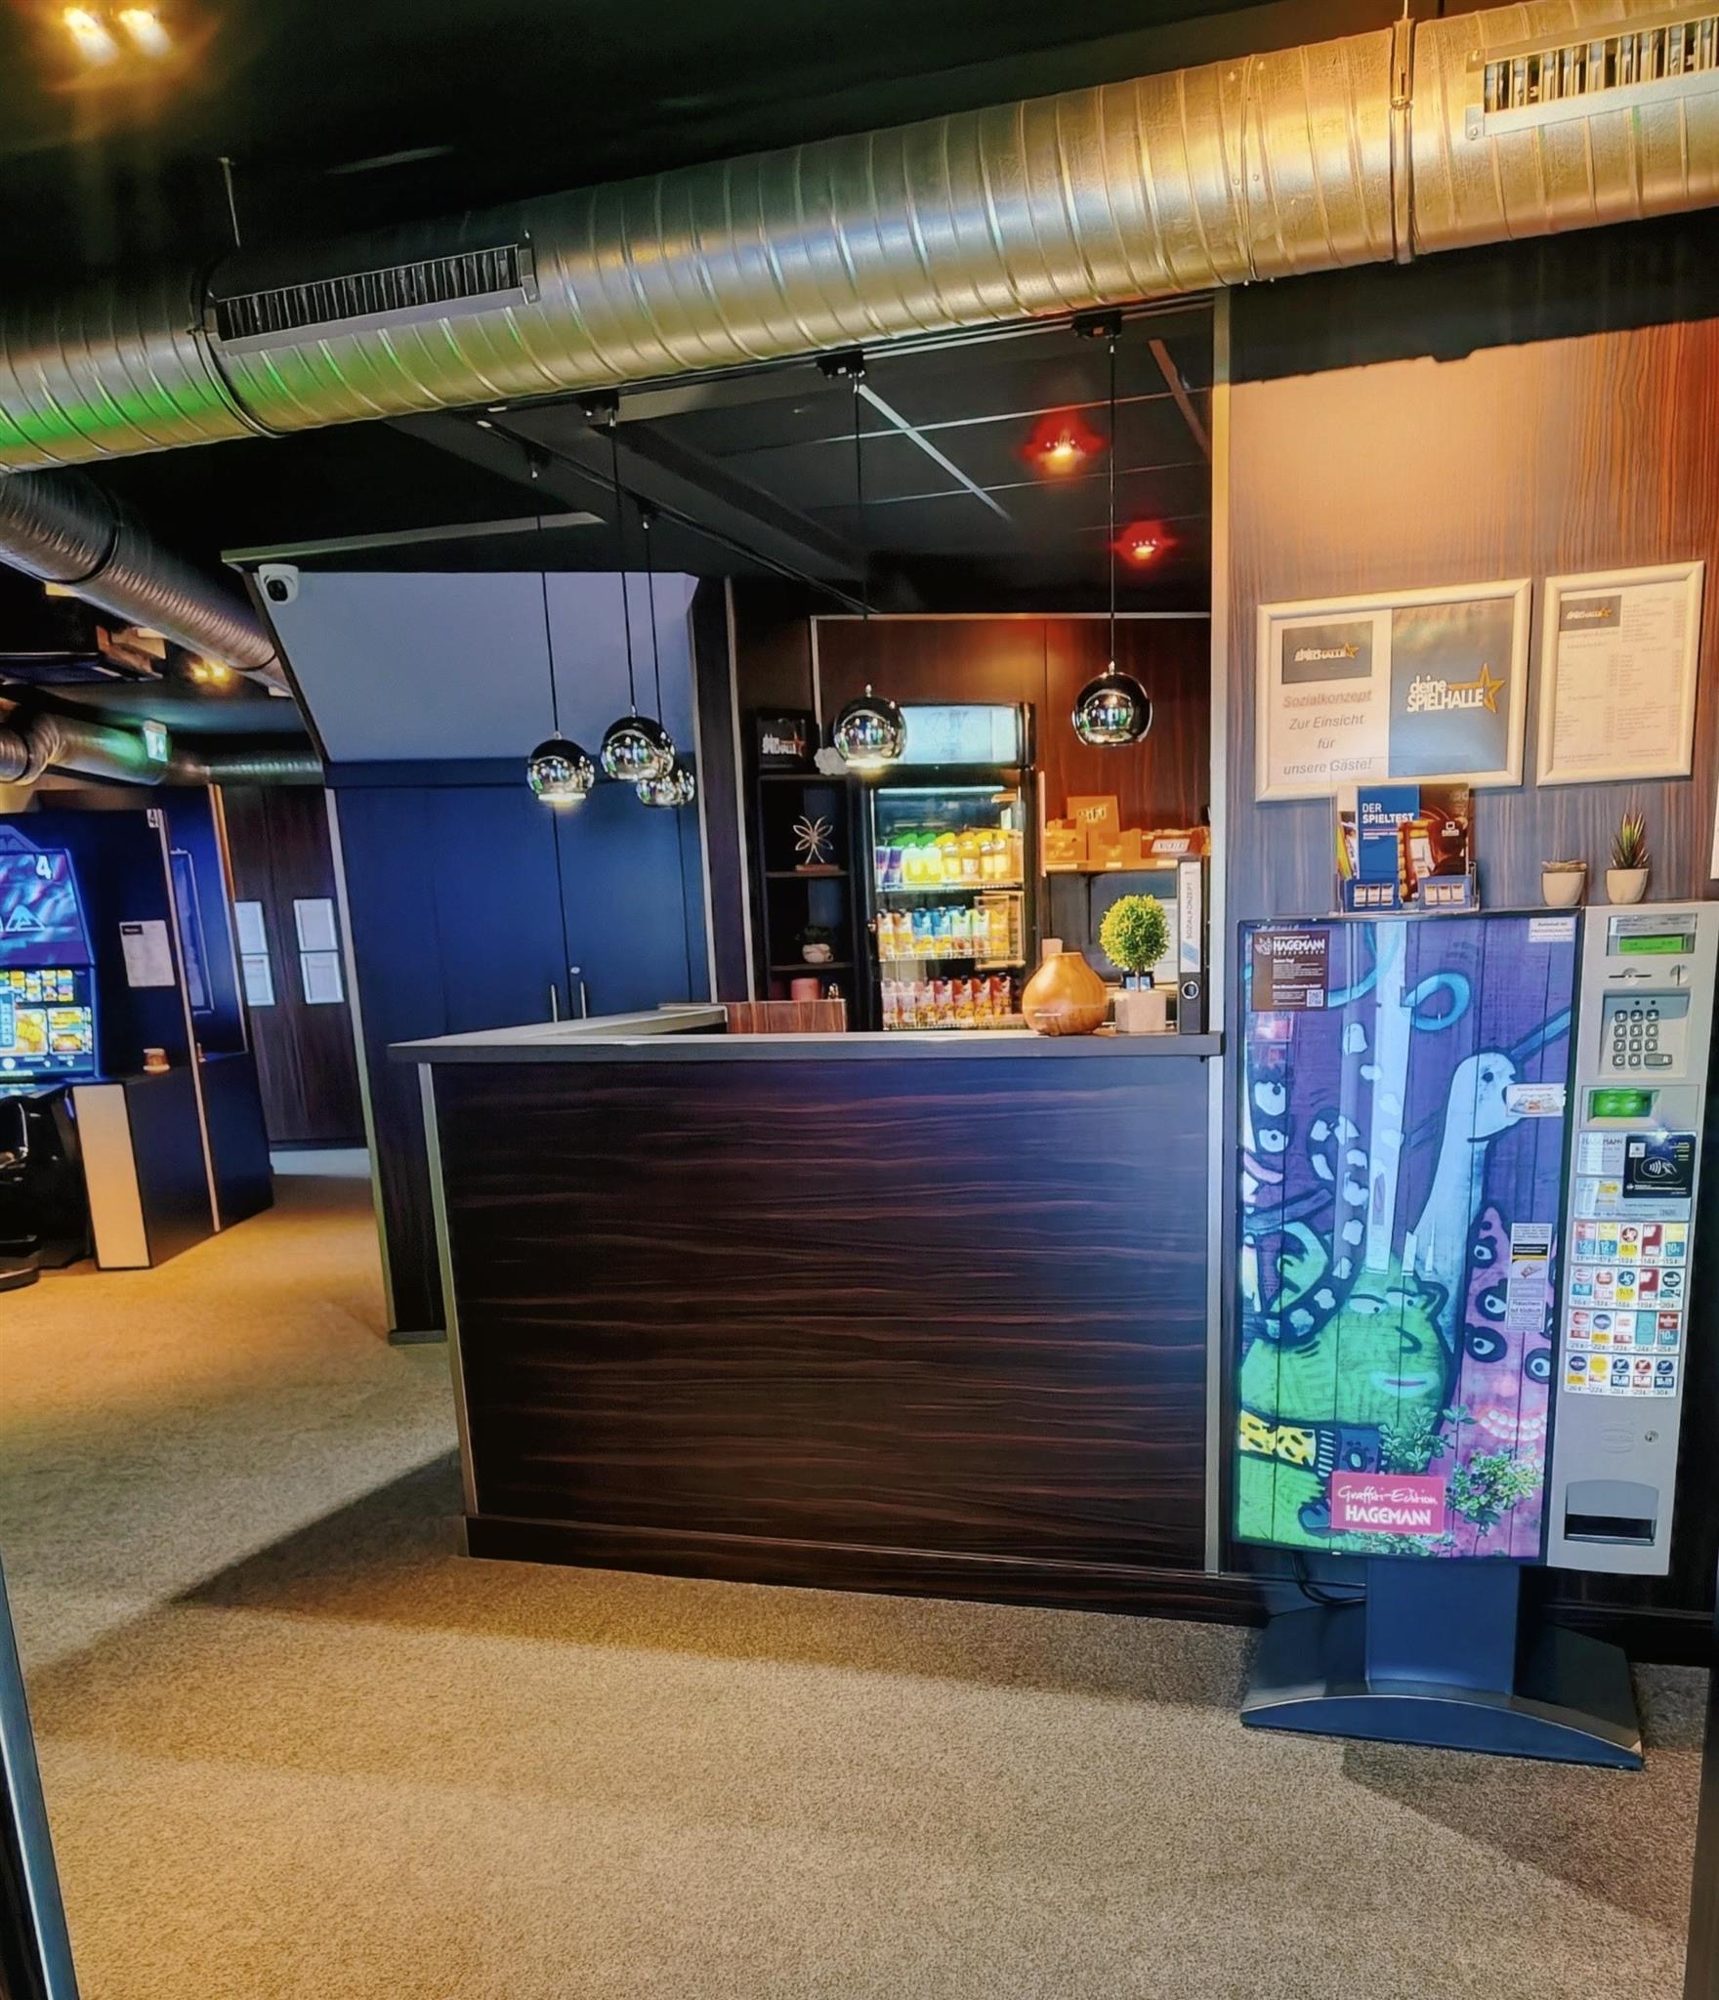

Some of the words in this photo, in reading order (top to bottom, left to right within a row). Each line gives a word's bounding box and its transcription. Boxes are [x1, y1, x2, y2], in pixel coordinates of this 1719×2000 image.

[1410, 675, 1447, 694] deine
[1282, 689, 1373, 709] Sozialkonzept
[1406, 687, 1484, 713] SPIELHALLE
[1289, 717, 1310, 731] Zur
[1313, 713, 1365, 729] Einsicht
[1317, 737, 1336, 750] für
[1283, 761, 1327, 775] unsere
[1329, 758, 1373, 773] Gäste!
[1361, 803, 1382, 813] DER
[1362, 812, 1415, 824] SPIELTEST
[1273, 938, 1326, 952] HAGEMANN
[1345, 1504, 1432, 1526] HAGEMANN
